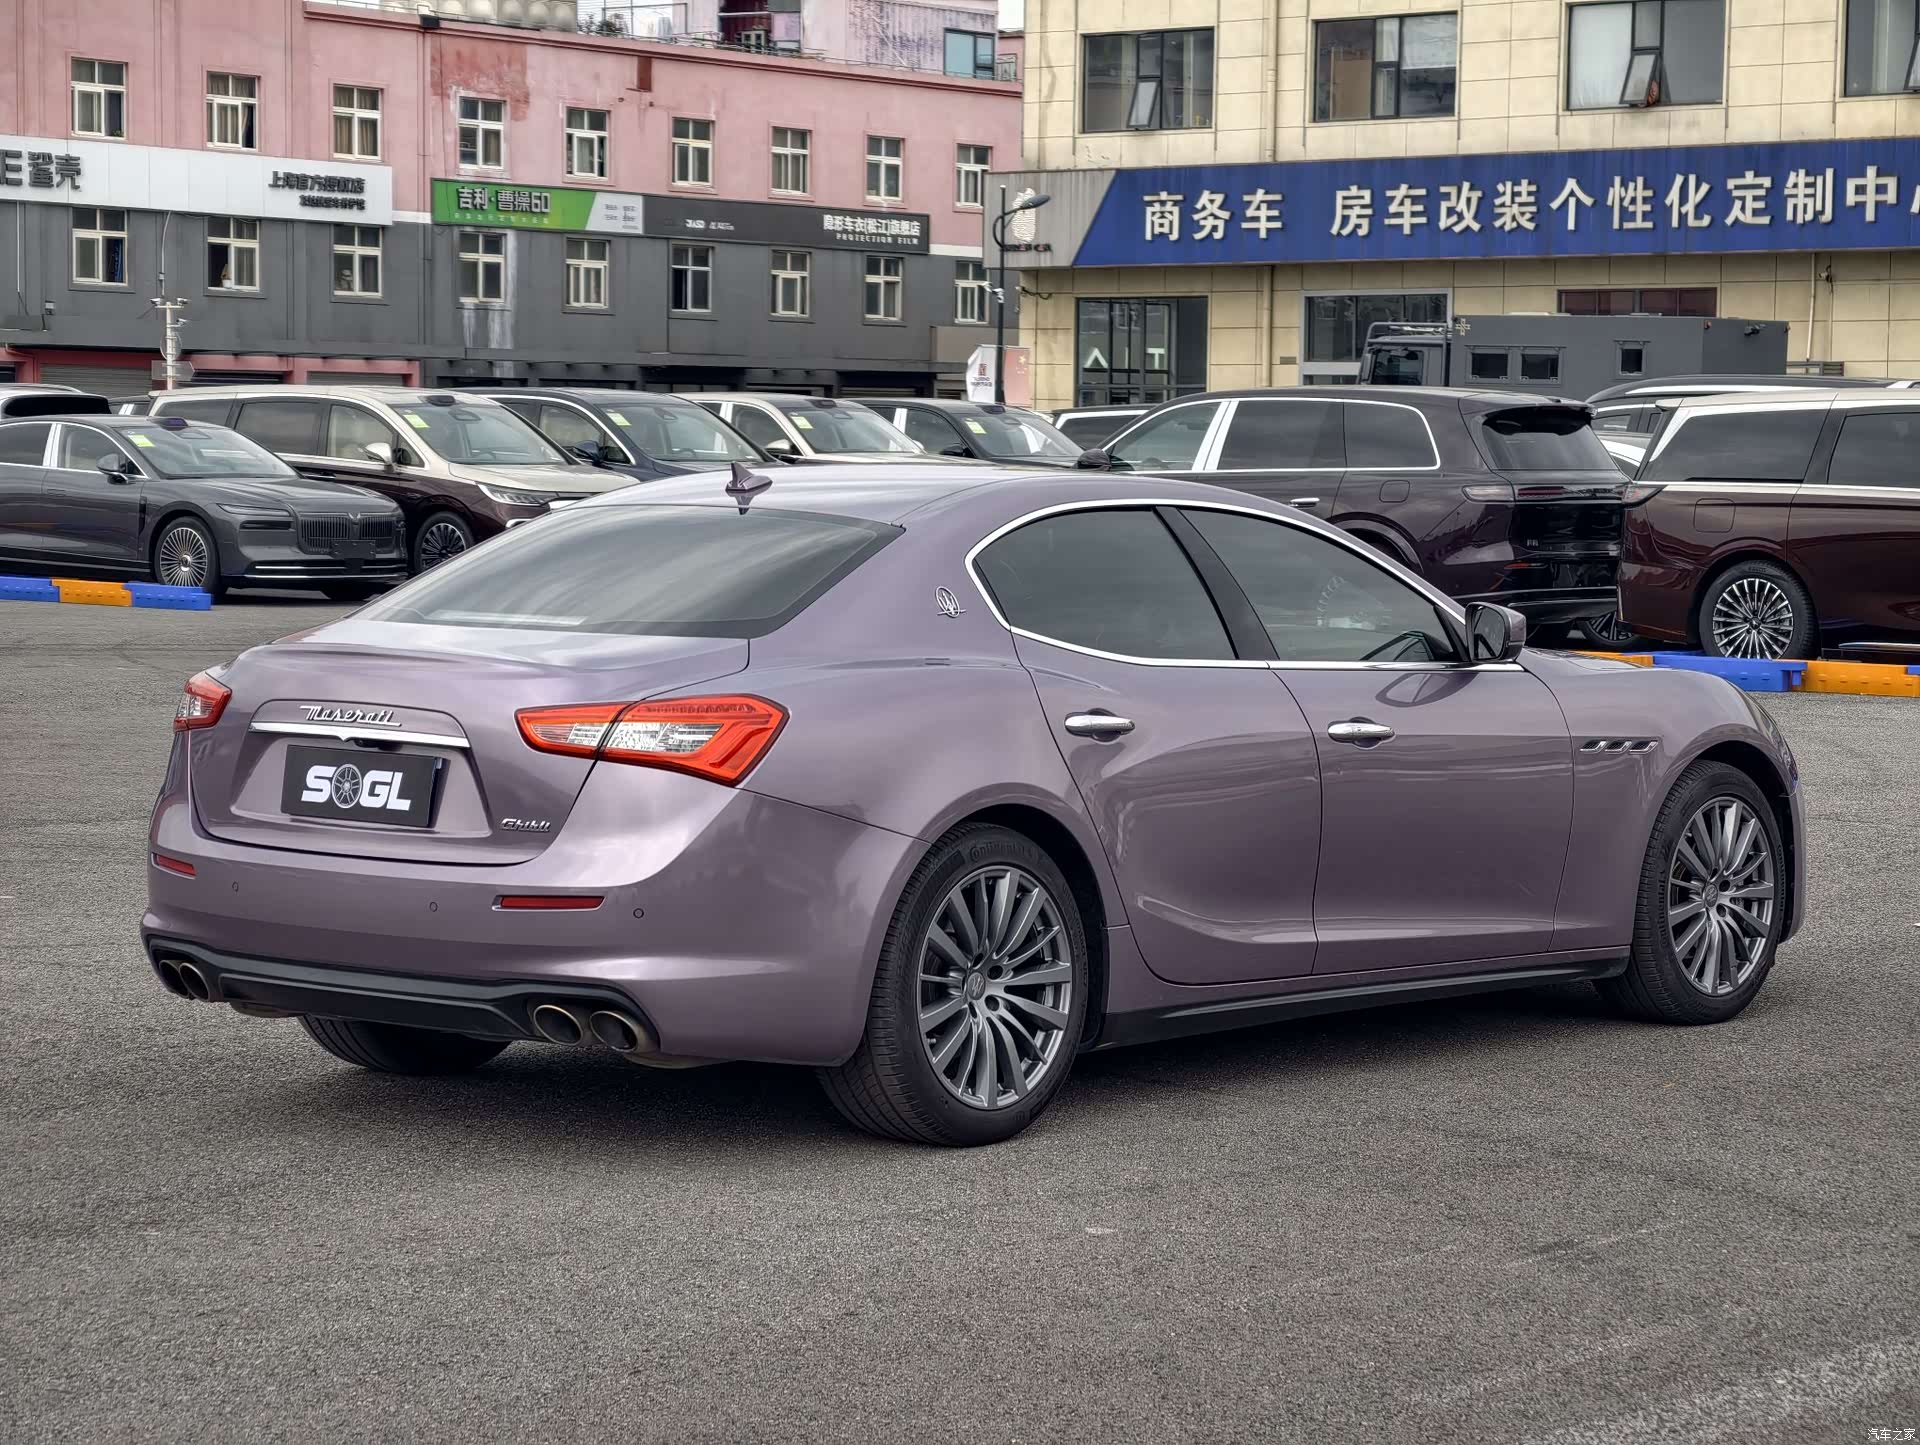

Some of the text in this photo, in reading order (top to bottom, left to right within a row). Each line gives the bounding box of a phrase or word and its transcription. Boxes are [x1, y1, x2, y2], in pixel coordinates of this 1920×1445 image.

[1143, 165, 1920, 241] 商务车 房车改装个性化定制中
[897, 236, 919, 245] FILM
[300, 705, 402, 728] Maserati
[501, 818, 551, 832] Ghibli
